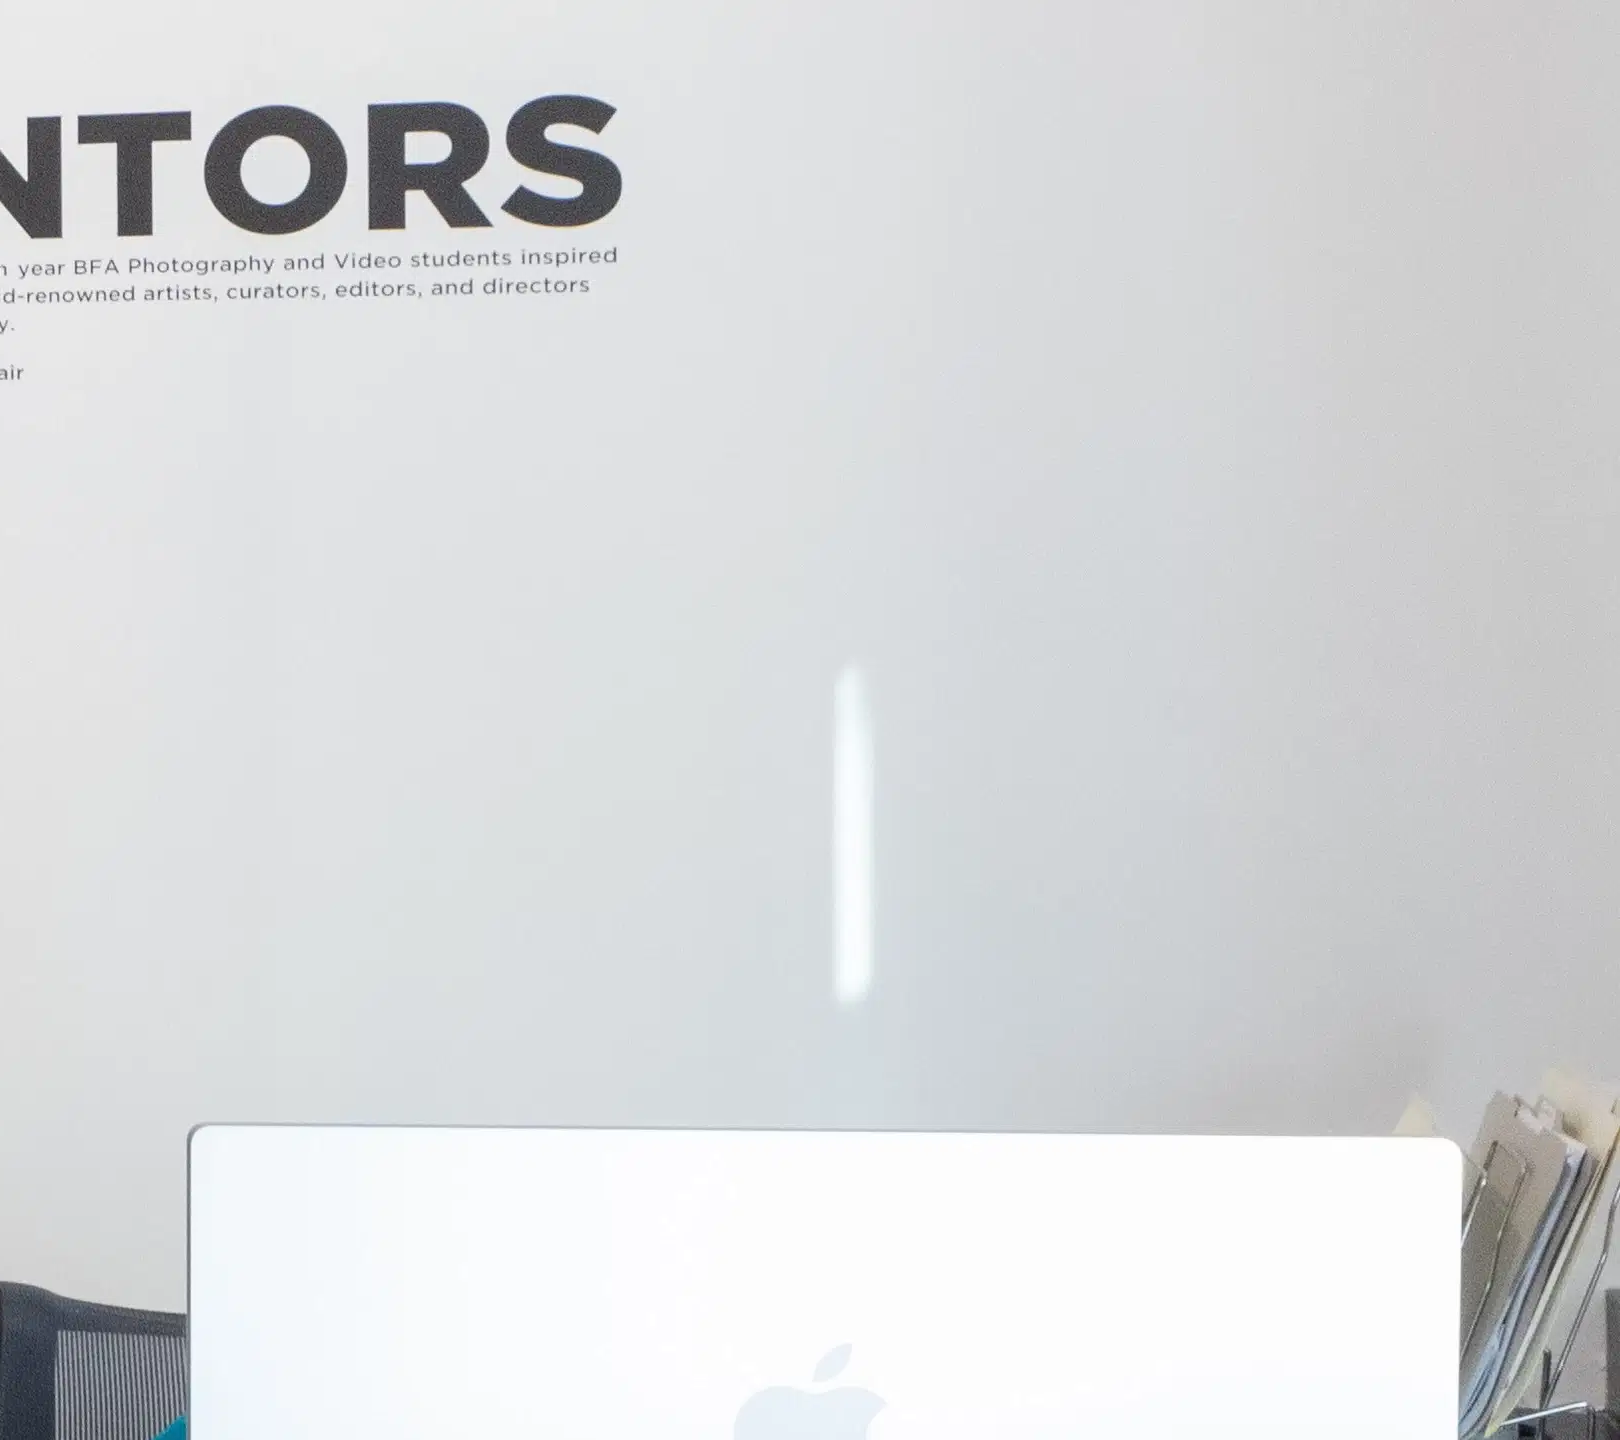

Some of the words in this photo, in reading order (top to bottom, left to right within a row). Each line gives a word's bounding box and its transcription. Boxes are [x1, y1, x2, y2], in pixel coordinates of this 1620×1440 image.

[18, 263, 65, 280] year
[73, 258, 120, 276] BFA
[128, 255, 275, 276] Photography
[283, 253, 325, 271] and
[334, 252, 402, 269] Video
[410, 250, 512, 268] students
[521, 246, 618, 268] inspired
[143, 285, 218, 302] artists,
[226, 283, 326, 300] curators,
[335, 280, 422, 298] editors,
[431, 278, 474, 296] and
[482, 277, 590, 295] directors
